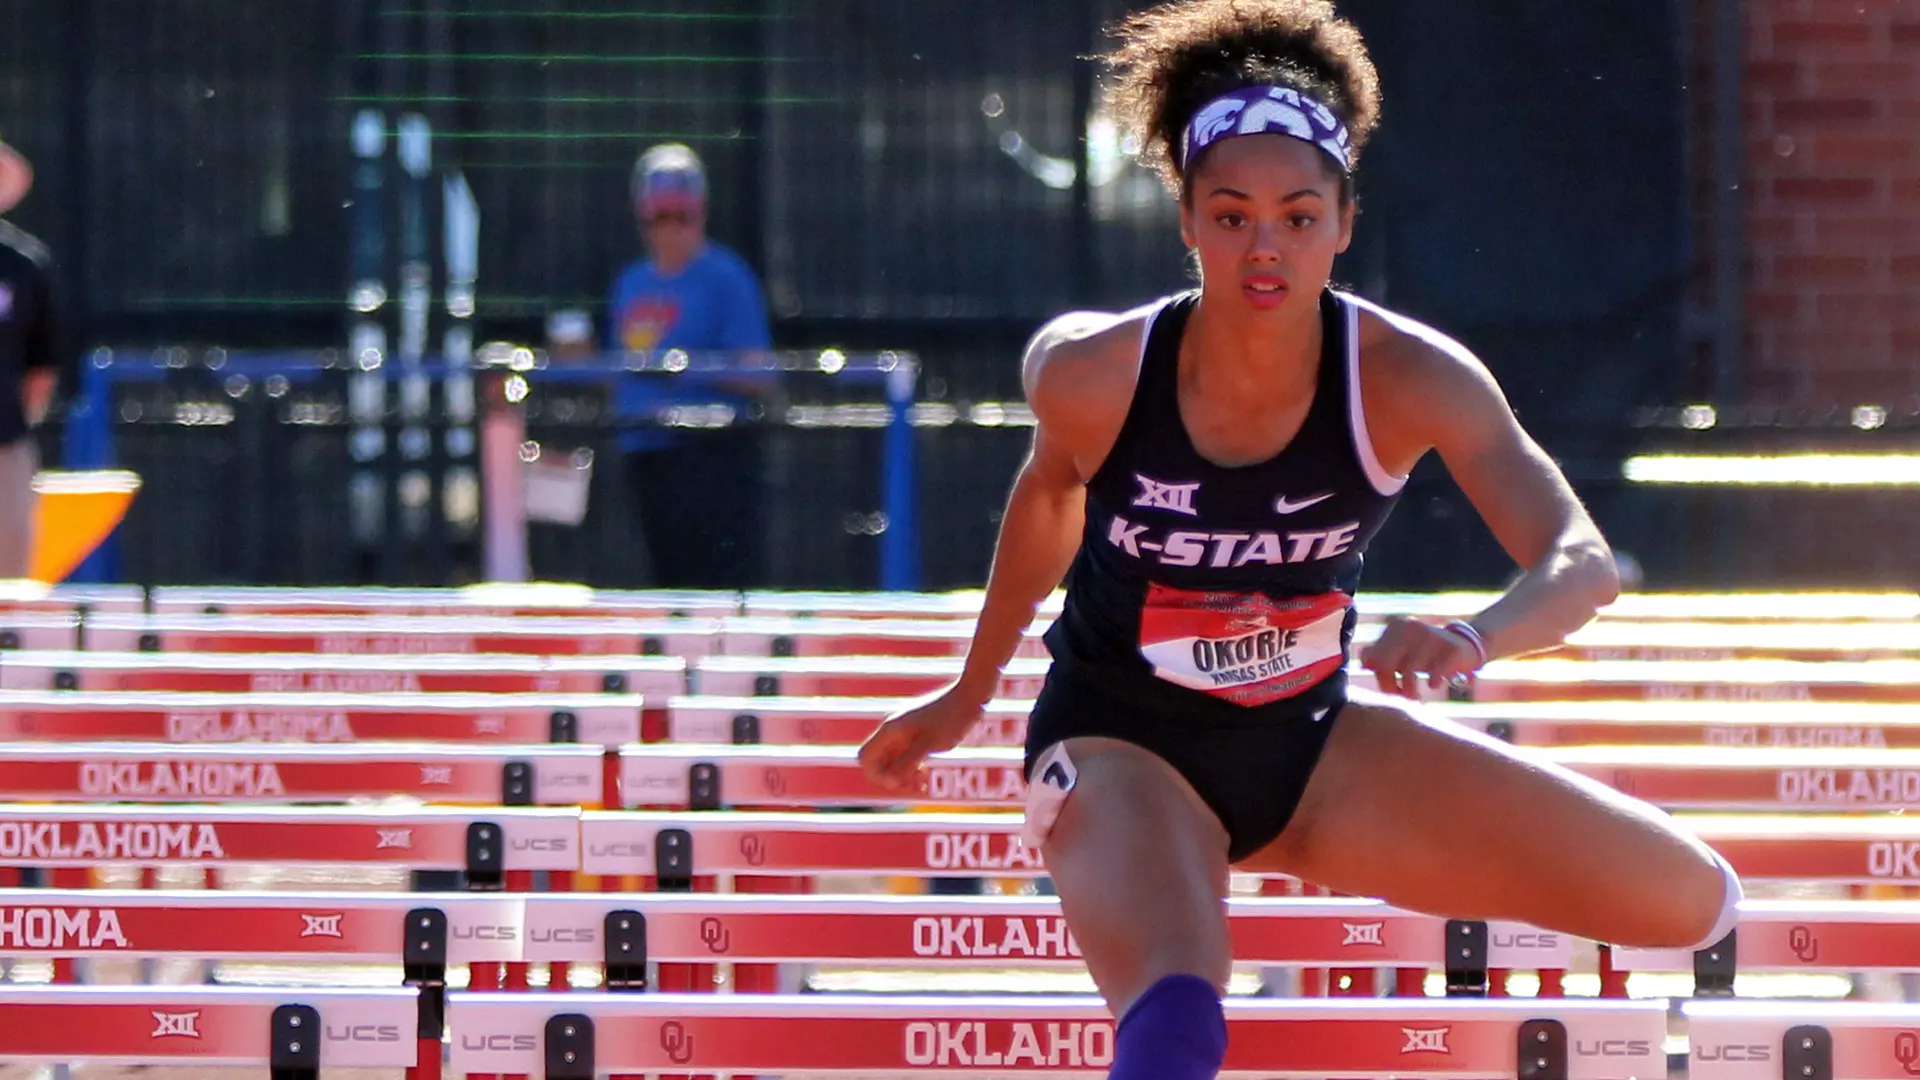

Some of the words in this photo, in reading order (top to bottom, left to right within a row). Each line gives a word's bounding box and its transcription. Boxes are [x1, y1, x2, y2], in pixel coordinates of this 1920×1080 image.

[1107, 515, 1360, 568] K-STATE
[1259, 652, 1294, 678] STATE
[79, 762, 286, 796] OKLAHOMA
[0, 822, 224, 858] OKLAHOMA
[509, 837, 567, 851] UCS
[589, 843, 648, 856] UCS
[1867, 842, 1920, 877] OK
[0, 908, 127, 947] HOMA
[453, 926, 516, 940] UCS
[531, 928, 595, 943] UCS
[1493, 934, 1557, 948] UCS
[152, 1012, 200, 1038] XII
[326, 1025, 400, 1041] UCS
[462, 1035, 537, 1051] UCS
[905, 1022, 1114, 1066] OKLAHO
[1401, 1027, 1449, 1053] XII
[1577, 1041, 1651, 1056] UCS
[1697, 1045, 1771, 1061] UCS
